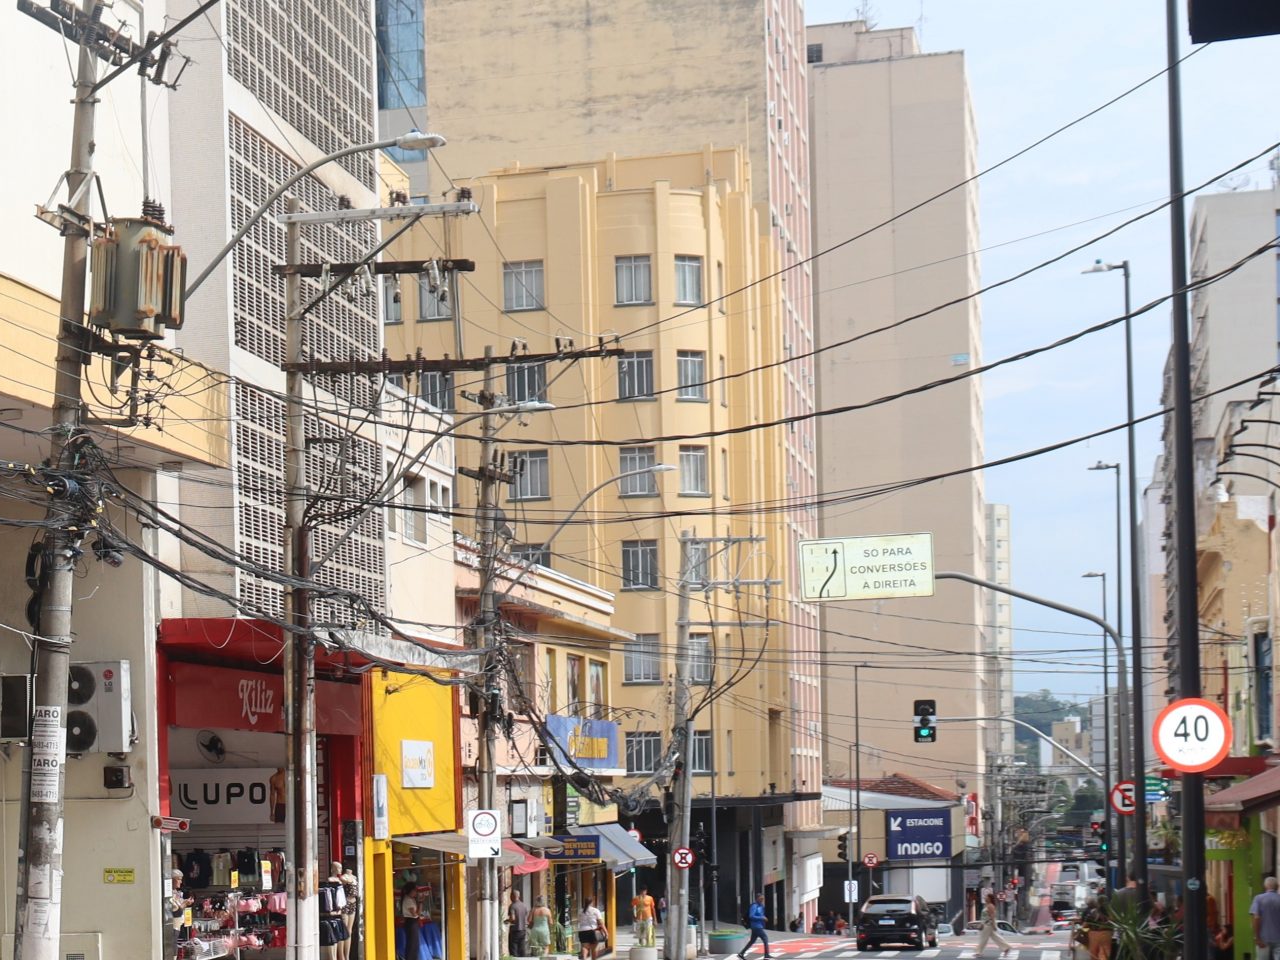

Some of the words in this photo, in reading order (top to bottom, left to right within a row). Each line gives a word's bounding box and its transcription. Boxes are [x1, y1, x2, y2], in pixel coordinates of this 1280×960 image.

[882, 546, 913, 556] PARA
[873, 578, 917, 589] DIREITA
[238, 678, 274, 725] Kiliz
[1173, 714, 1209, 743] 40
[178, 781, 266, 810] LUPO
[906, 817, 944, 827] ESTACIONE
